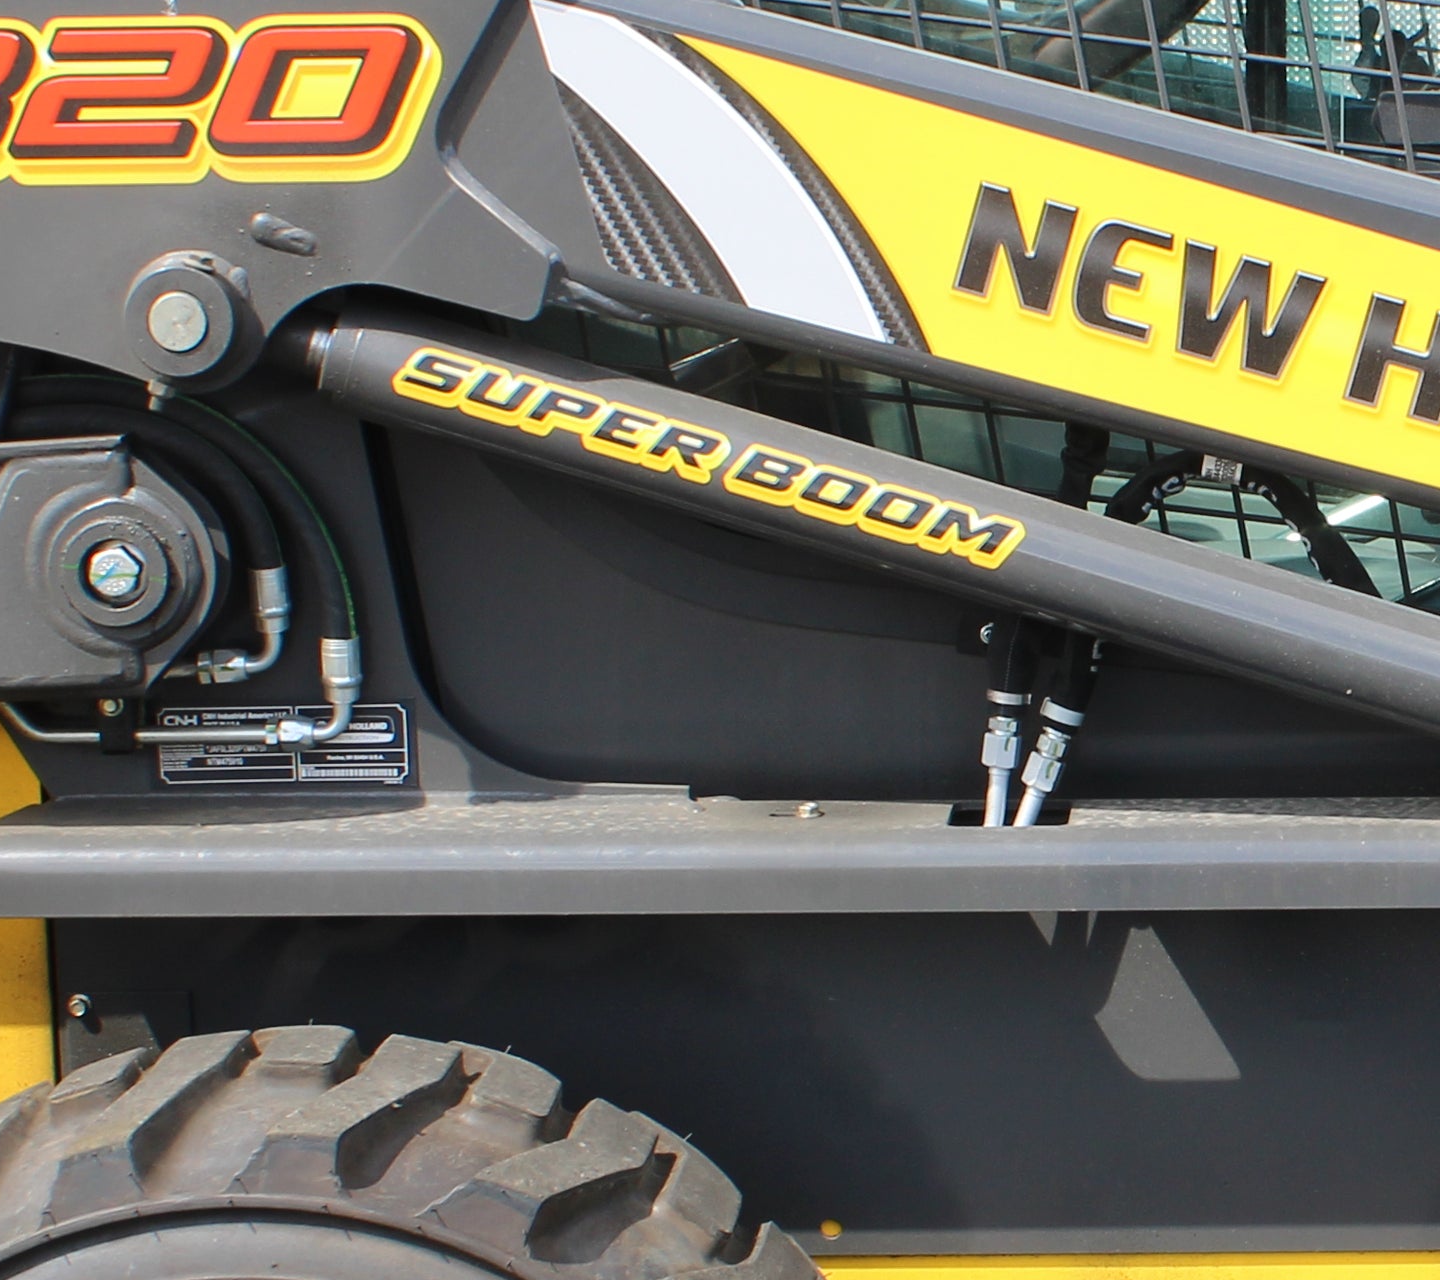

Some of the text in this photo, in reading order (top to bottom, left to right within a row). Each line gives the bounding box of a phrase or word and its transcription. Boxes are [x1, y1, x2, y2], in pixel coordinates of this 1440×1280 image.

[953, 181, 1328, 380] NEW
[398, 351, 1018, 556] SUPER BOOM
[163, 714, 198, 726] CNH
[348, 722, 388, 731] HOLLAND
